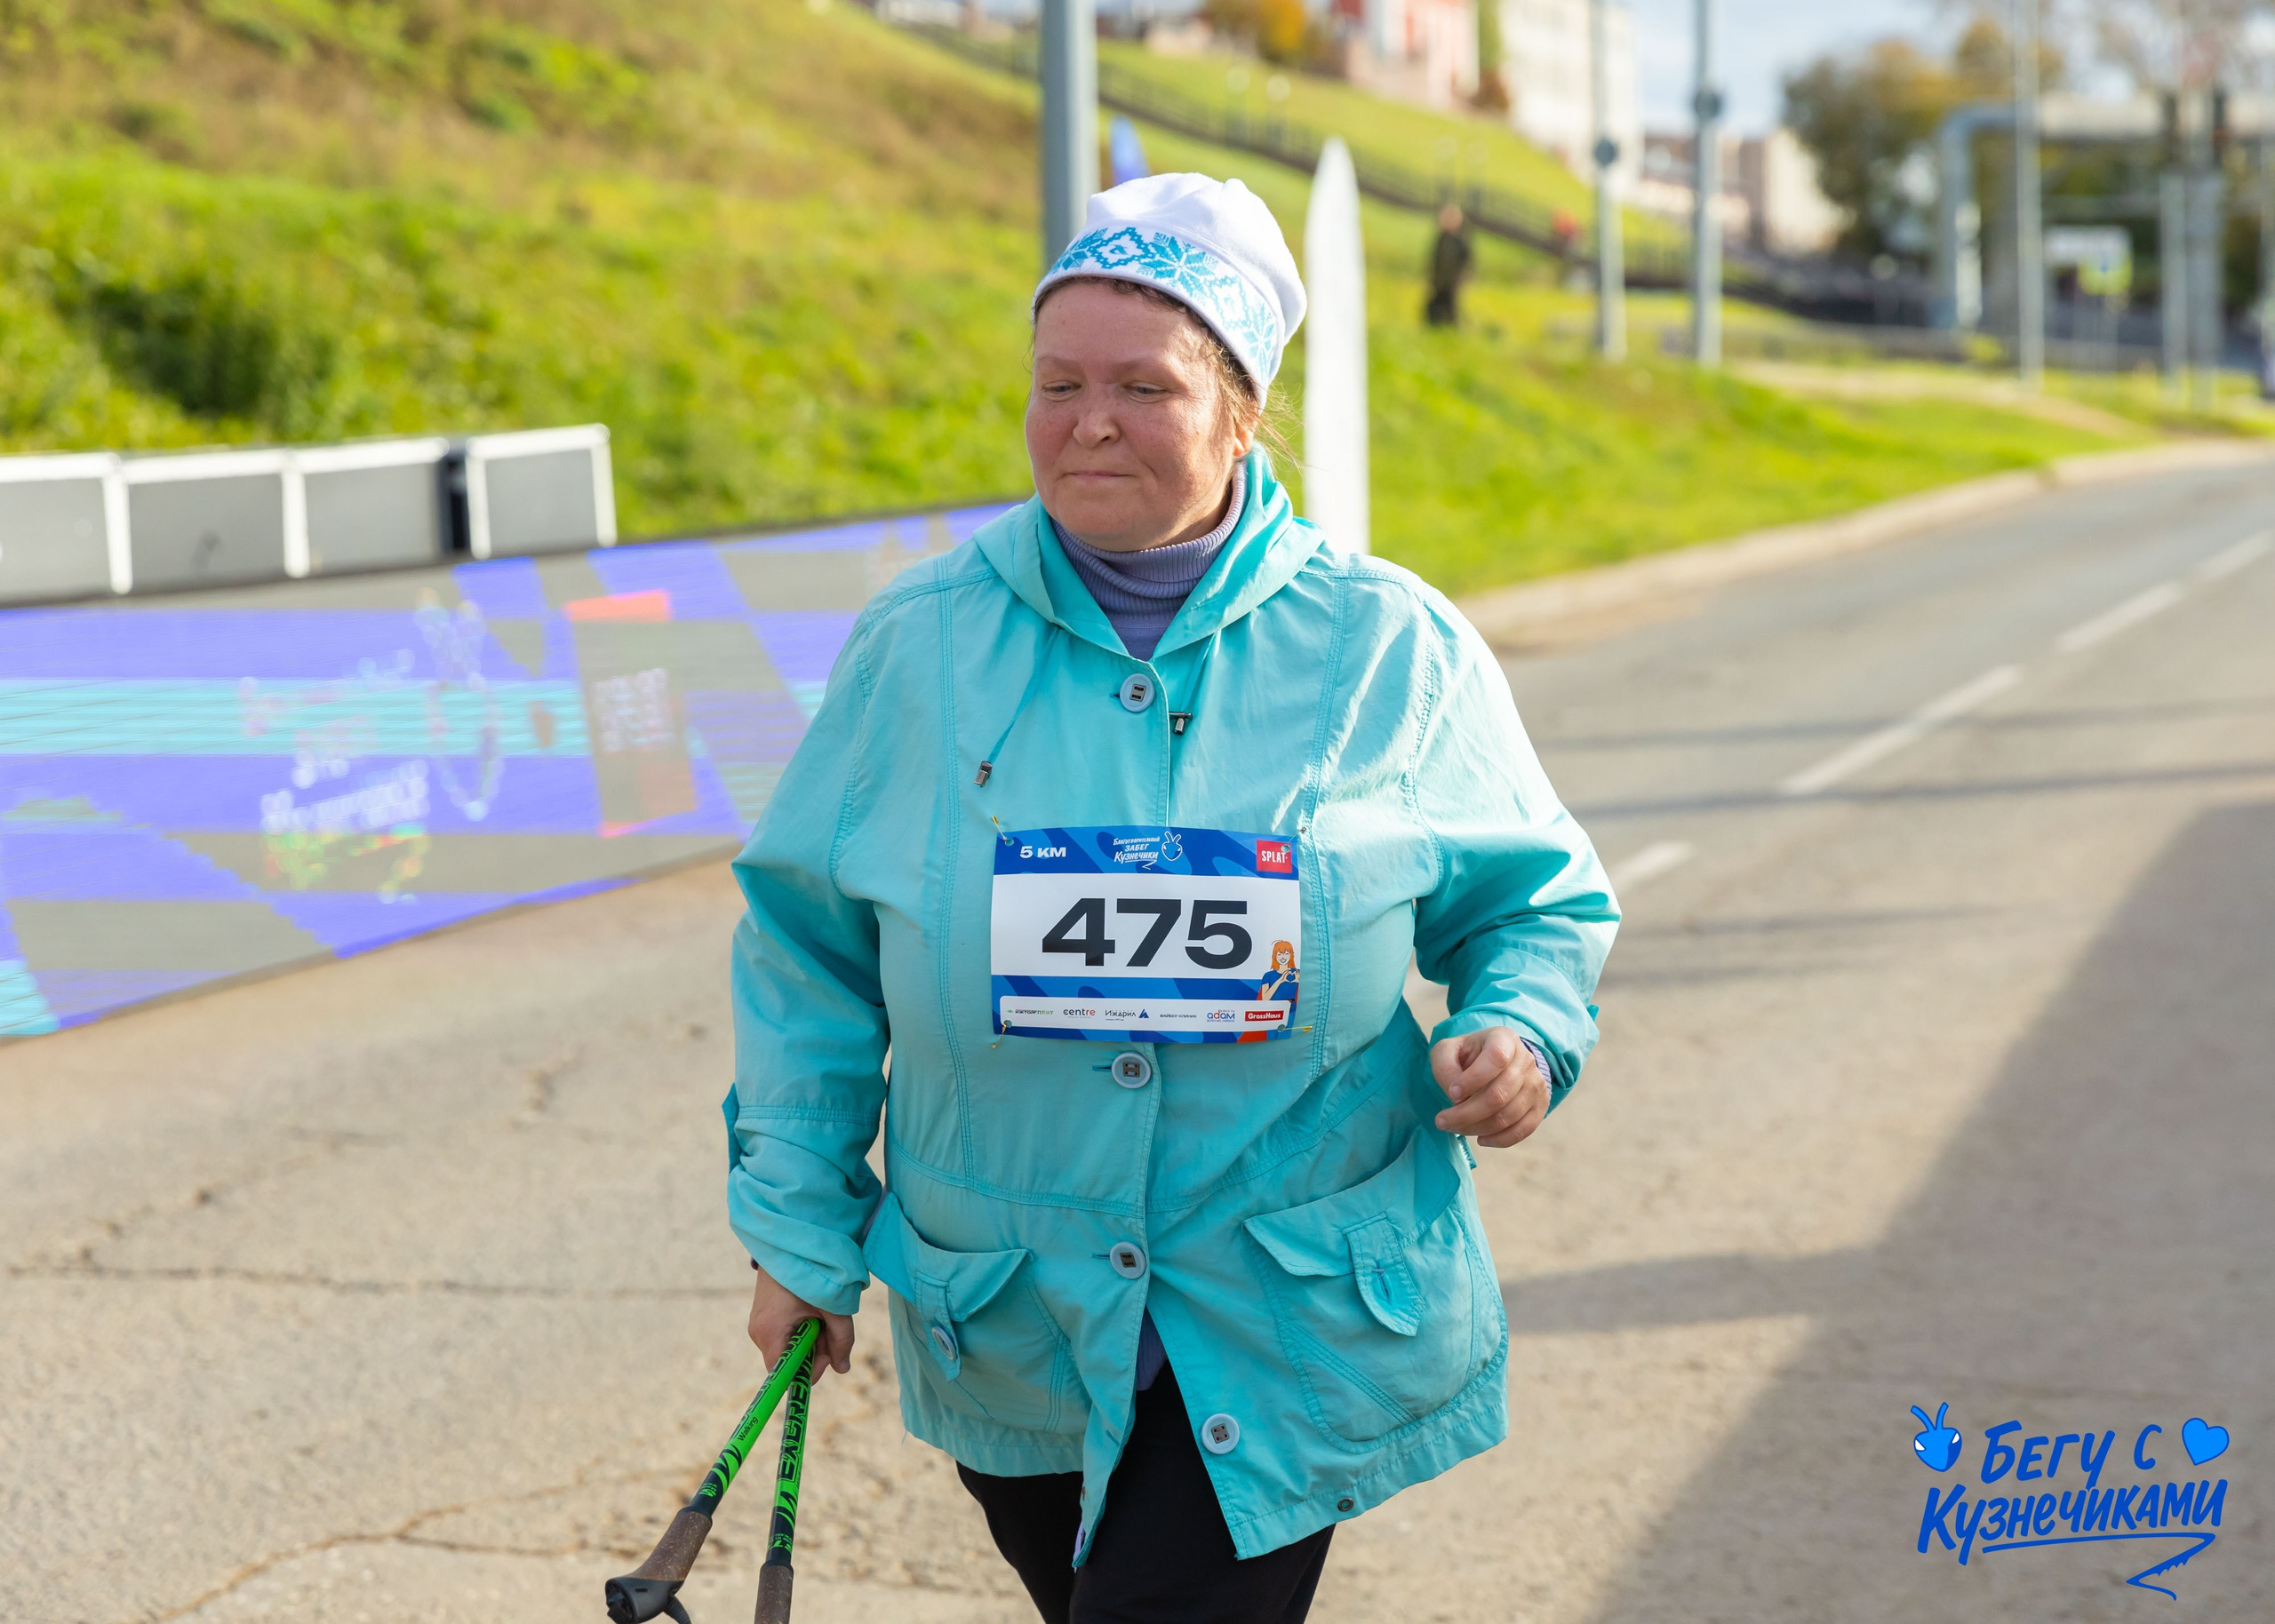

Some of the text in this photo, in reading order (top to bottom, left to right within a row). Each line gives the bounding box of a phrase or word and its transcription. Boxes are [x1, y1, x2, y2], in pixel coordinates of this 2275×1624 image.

[1019, 845, 1034, 859] 5
[1124, 843, 1150, 852] ЗАБЕГ
[1114, 850, 1159, 864] Кузнечики
[1261, 850, 1287, 864] SPLAT
[1042, 897, 1253, 970] 475
[1063, 1007, 1096, 1016] centre
[737, 1415, 760, 1442] Walking
